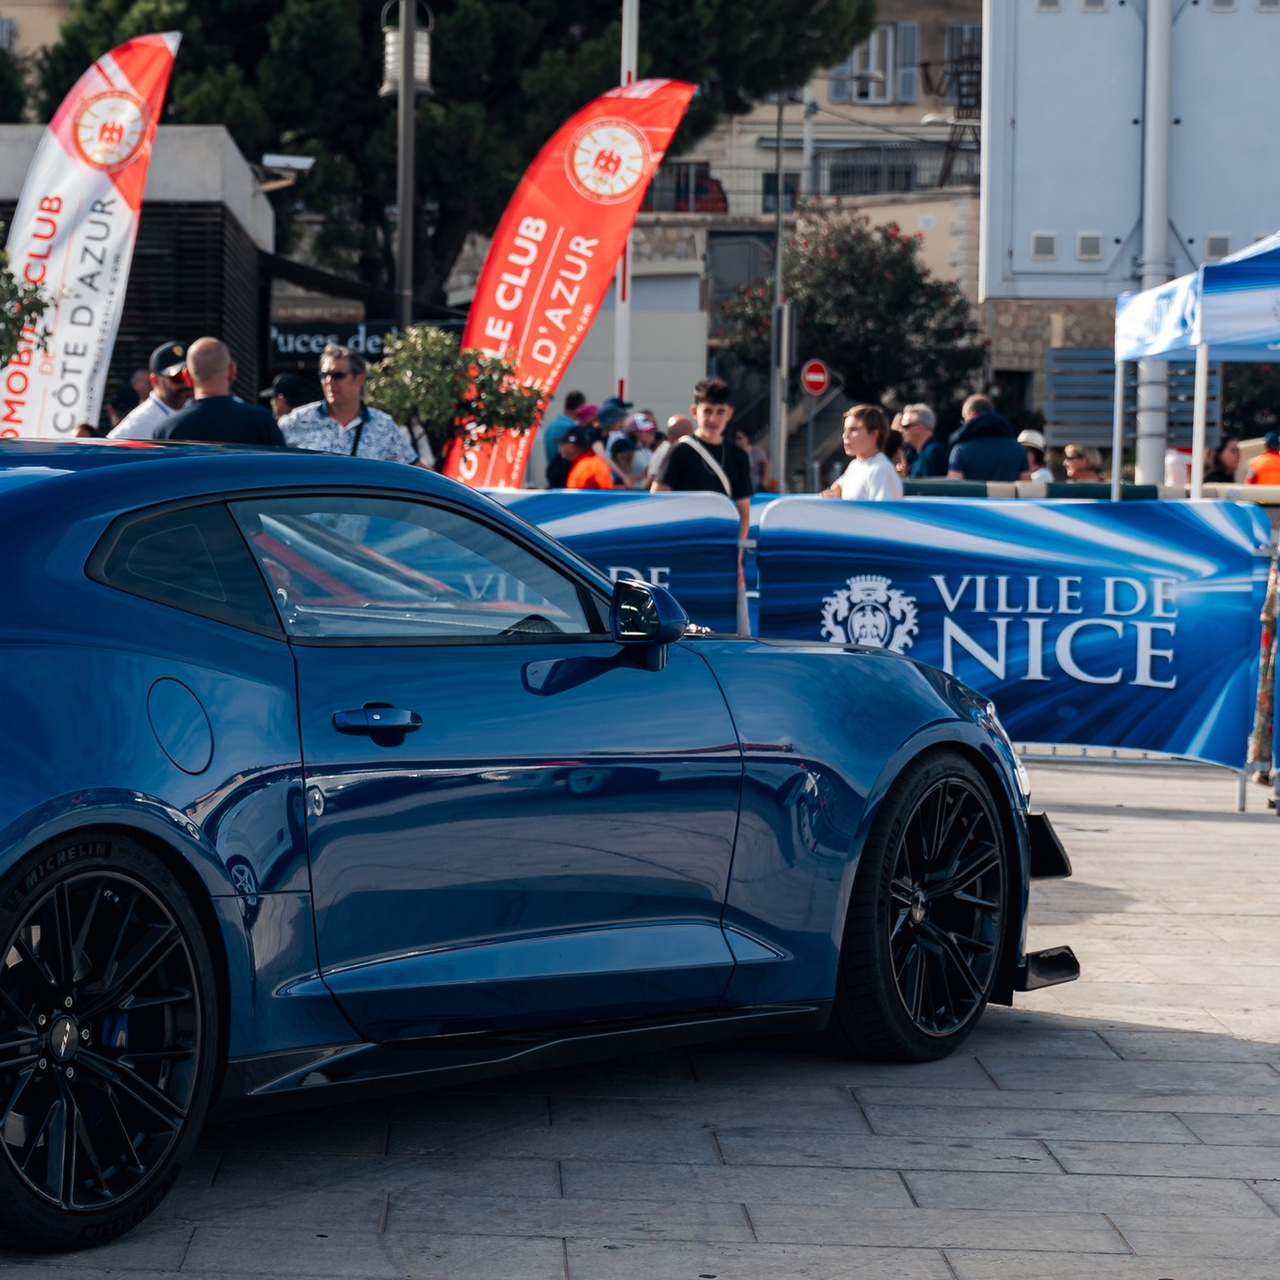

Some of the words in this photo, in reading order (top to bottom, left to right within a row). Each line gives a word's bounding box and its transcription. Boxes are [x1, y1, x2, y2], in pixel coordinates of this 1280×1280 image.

[24, 196, 63, 284] CLUB
[494, 216, 548, 311] CLUB
[51, 342, 88, 433] CÔTE
[70, 199, 117, 327] D'AZUR
[348, 324, 383, 353] de
[531, 235, 600, 365] D'AZUR
[928, 573, 1083, 615] VILLE
[1103, 575, 1180, 618] DE
[941, 616, 1177, 689] NICE
[24, 840, 108, 892] MICHELIN
